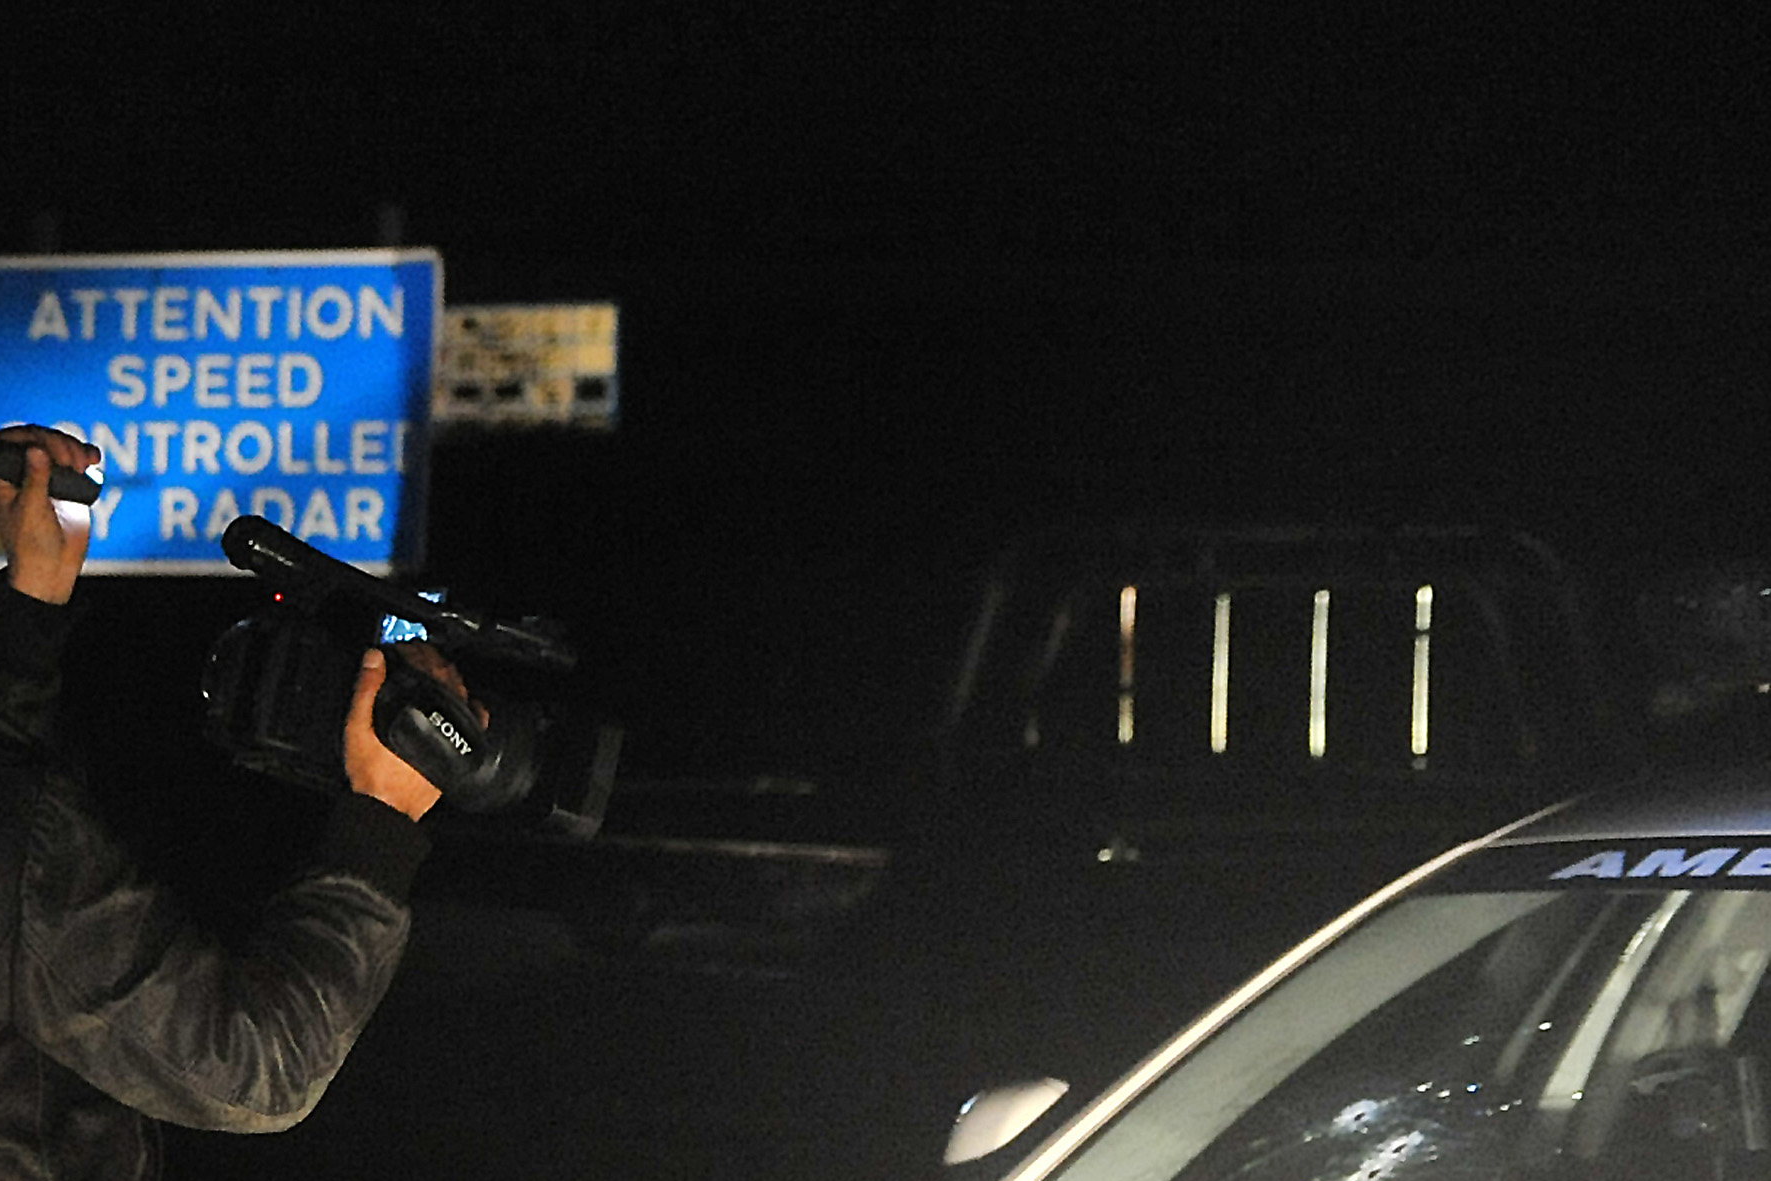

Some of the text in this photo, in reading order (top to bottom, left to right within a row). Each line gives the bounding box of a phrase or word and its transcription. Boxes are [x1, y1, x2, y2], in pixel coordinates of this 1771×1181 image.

[28, 284, 405, 342] ATTENTION
[106, 352, 324, 409] SPEED
[0, 420, 409, 475] NTROLLE
[159, 485, 385, 542] RADAR
[428, 710, 473, 756] SONY
